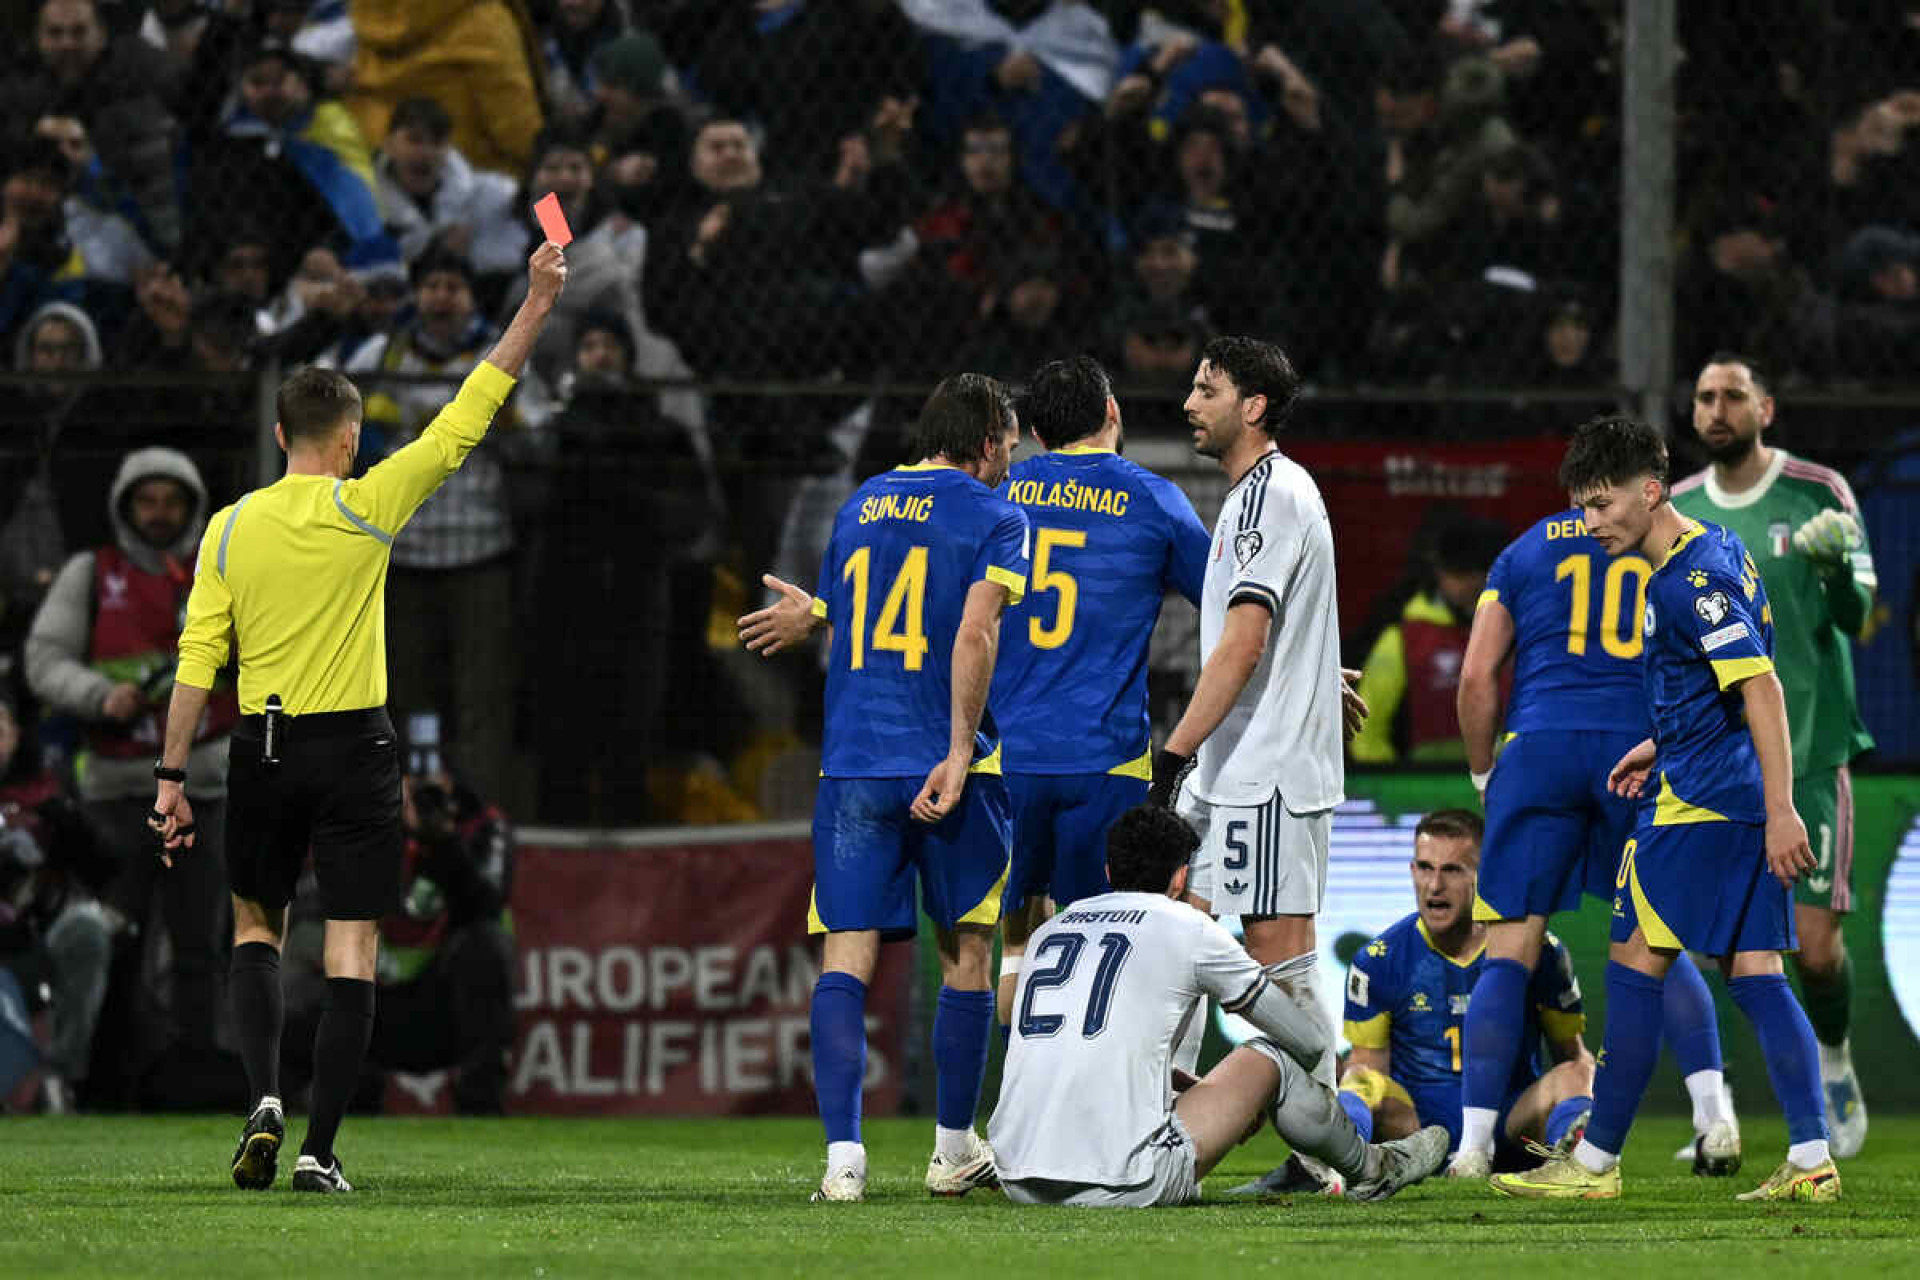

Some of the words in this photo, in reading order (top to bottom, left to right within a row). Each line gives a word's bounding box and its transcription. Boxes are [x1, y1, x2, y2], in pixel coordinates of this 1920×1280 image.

[858, 494, 934, 524] ŠUNJIĆ
[1007, 478, 1129, 517] KOLAŠINAC
[843, 546, 930, 672] 14
[1028, 527, 1088, 650] 5
[1555, 554, 1652, 660] 10
[1223, 820, 1248, 869] 5
[1061, 909, 1148, 925] BASTONI
[513, 945, 824, 1012] UROPEAN
[1019, 932, 1133, 1040] 21
[512, 1018, 888, 1095] ALIFIER
[1442, 1026, 1463, 1073] 1
